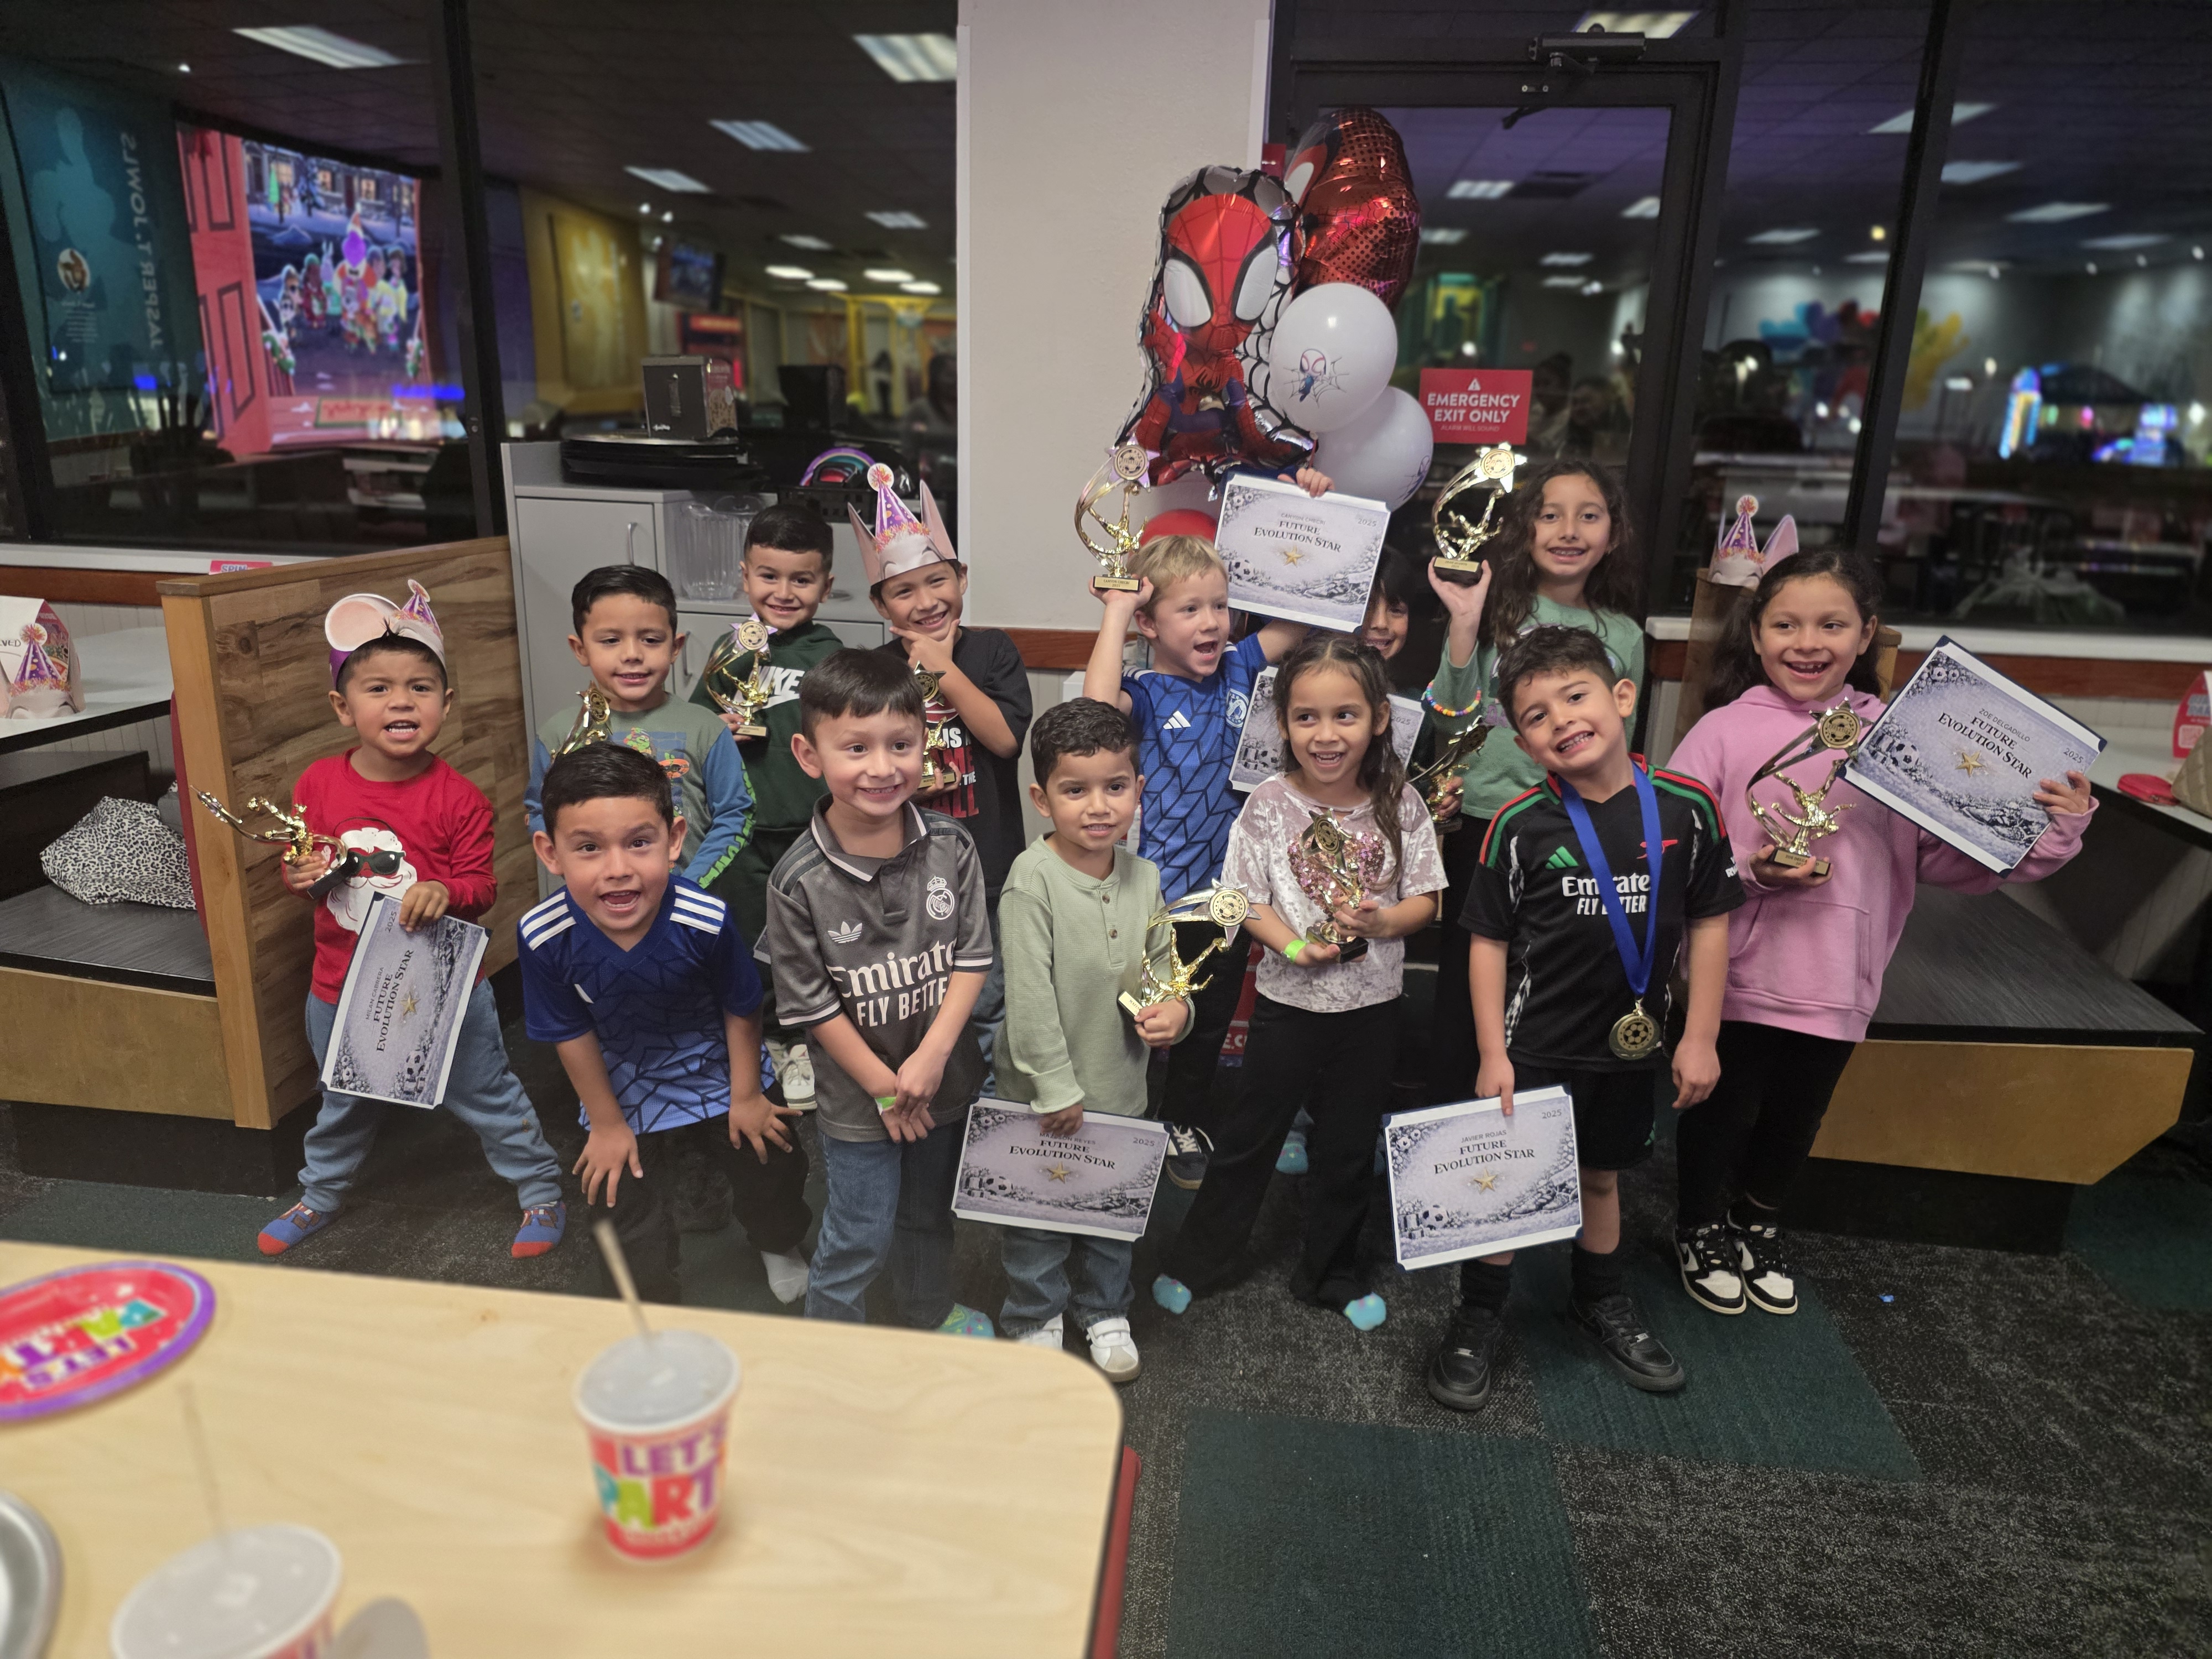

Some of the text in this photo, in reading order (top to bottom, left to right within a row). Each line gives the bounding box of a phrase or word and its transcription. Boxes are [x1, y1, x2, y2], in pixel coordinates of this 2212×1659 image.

[1427, 393, 1520, 408] EMERGENCY
[1434, 409, 1510, 423] EXIT ONLY
[1281, 513, 1303, 521] CANYON
[1358, 518, 1377, 527] 2025
[1279, 520, 1321, 535] FUTURE
[1254, 527, 1341, 552] EVOLUTION STAR
[1971, 716, 2017, 750] FUTURE
[1979, 708, 2030, 742] ZOE DELGADILLO
[1938, 712, 2032, 779] EVOLUTION STAR
[2063, 747, 2084, 764] 2025
[962, 771, 977, 785] THE
[1577, 898, 1599, 915] FLY
[385, 911, 397, 932] 2025
[366, 967, 384, 1020] MILAN CABRERA
[374, 973, 393, 1022] FUTURE
[377, 950, 414, 1052] EVOLUTION STAR
[857, 974, 950, 1027] FLY BETTE
[1542, 1109, 1562, 1119] 2025
[1133, 1137, 1155, 1146] 2025
[1460, 1129, 1506, 1143] JAVIER ROJAS
[1040, 1140, 1090, 1153] FUTURE
[1460, 1139, 1507, 1155] FUTURE
[1009, 1145, 1115, 1170] EVOLUTION STAR
[1434, 1149, 1535, 1175] EVOLUTION STAR
